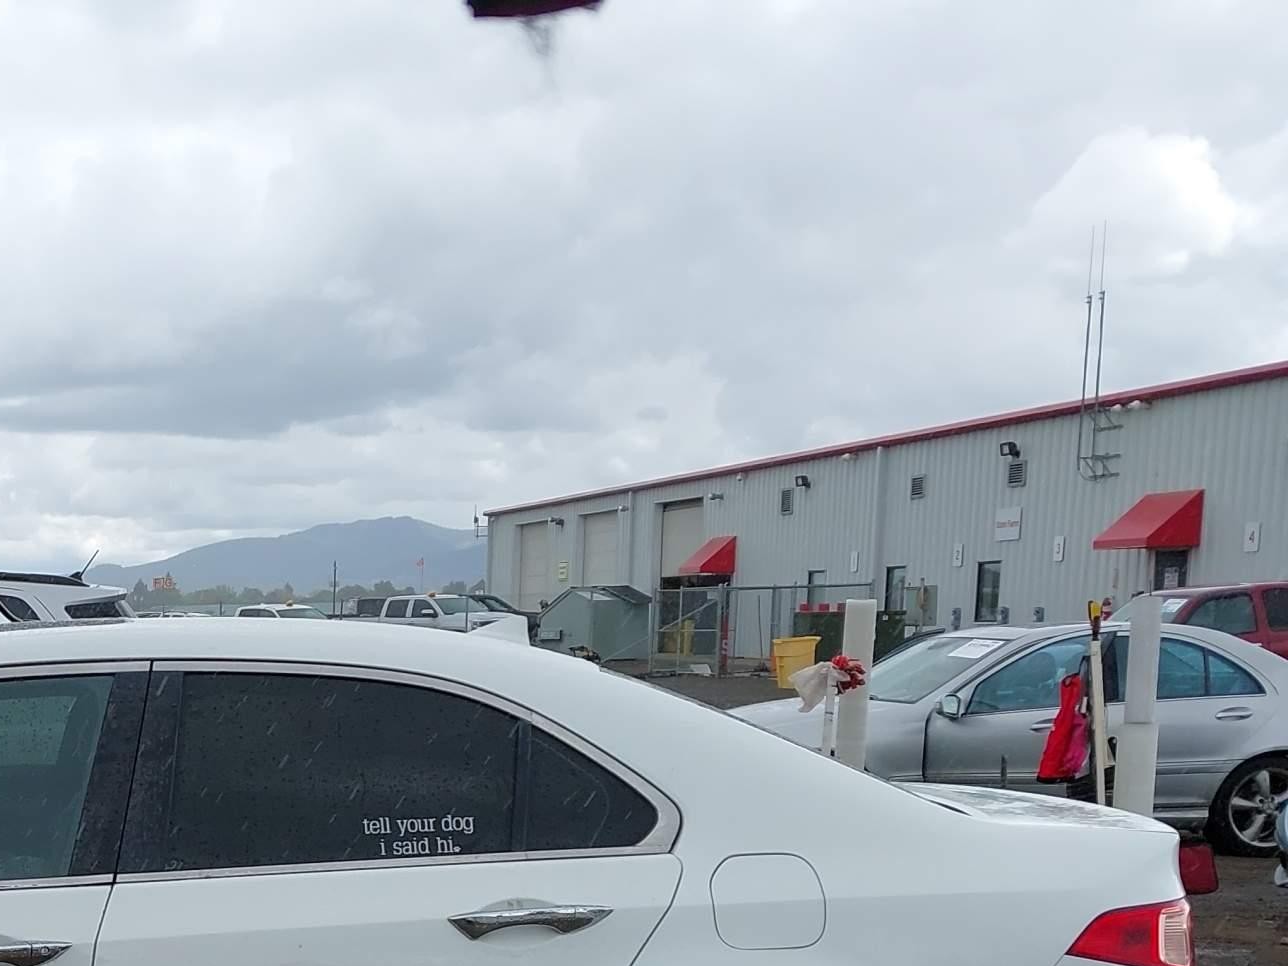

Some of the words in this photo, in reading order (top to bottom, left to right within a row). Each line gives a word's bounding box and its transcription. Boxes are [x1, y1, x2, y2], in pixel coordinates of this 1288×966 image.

[362, 817, 392, 835] tell
[397, 818, 436, 837] your
[441, 815, 474, 834] dog
[379, 839, 386, 856] i
[392, 837, 430, 855] said
